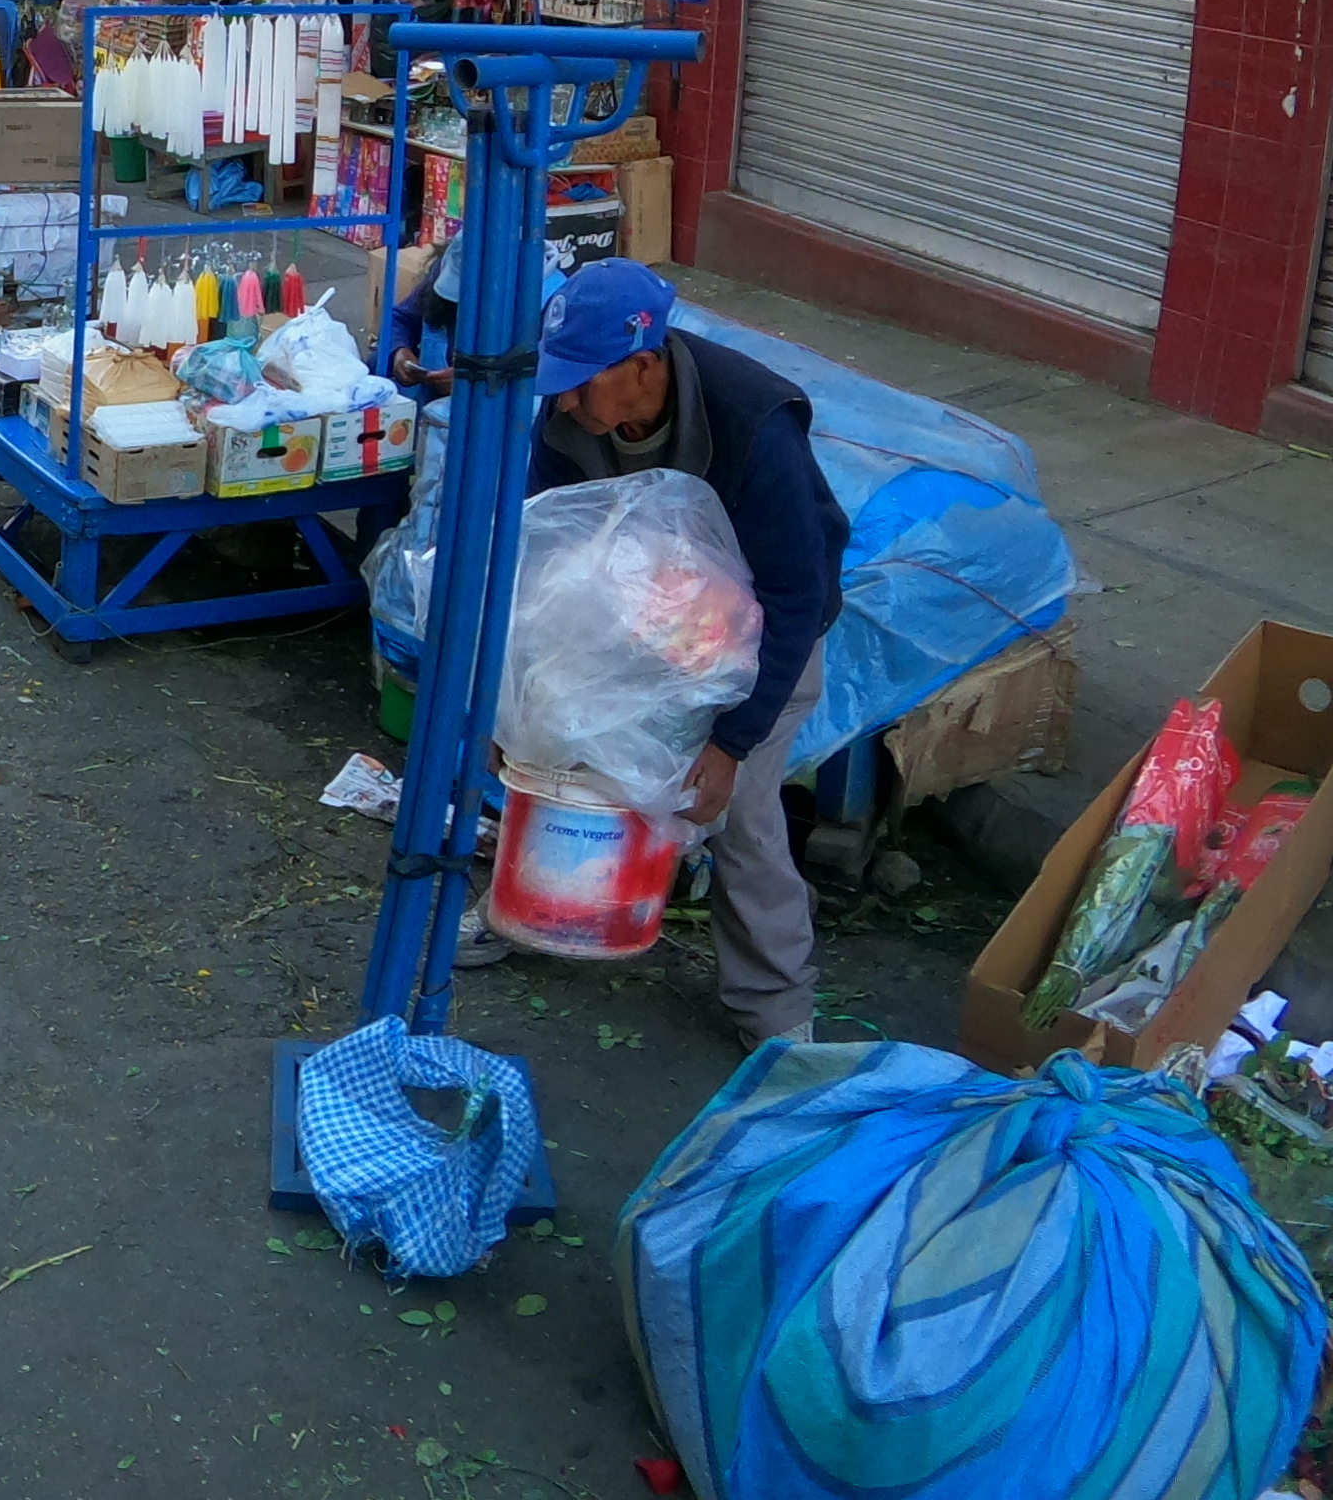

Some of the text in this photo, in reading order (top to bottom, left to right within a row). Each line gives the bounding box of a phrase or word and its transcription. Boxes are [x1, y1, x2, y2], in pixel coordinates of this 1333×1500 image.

[577, 231, 615, 250] Don
[545, 822, 625, 843] Creme Vegetal
